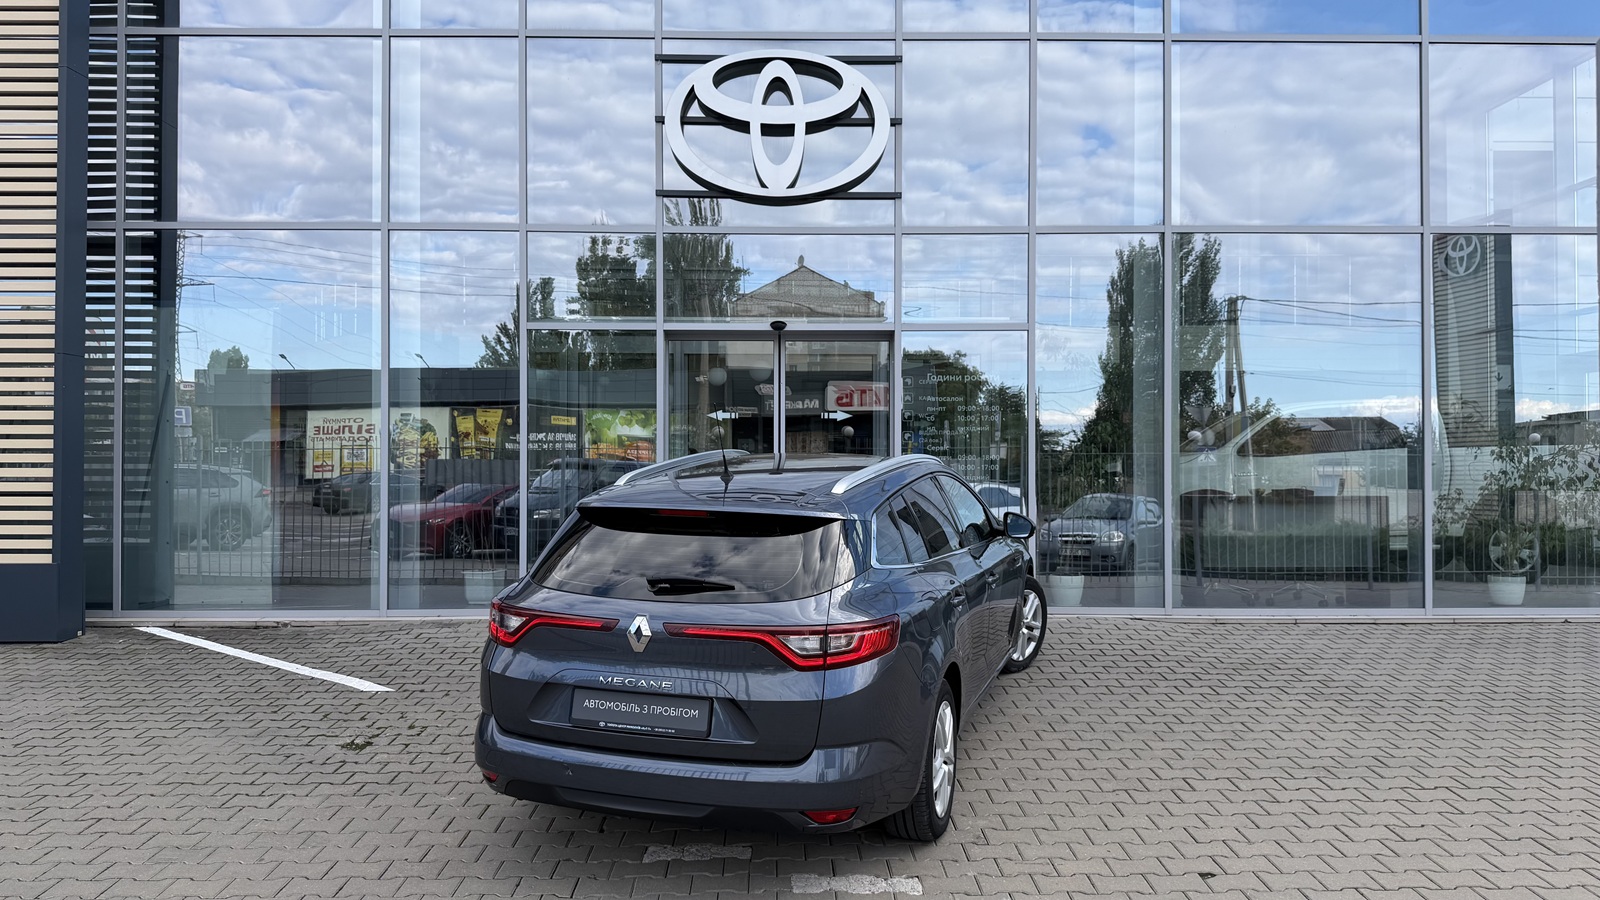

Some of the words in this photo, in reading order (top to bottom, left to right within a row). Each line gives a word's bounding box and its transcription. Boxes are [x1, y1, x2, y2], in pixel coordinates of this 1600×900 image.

[927, 373, 961, 382] Години
[962, 473, 990, 481] ихідний
[599, 675, 674, 691] MEGANE
[583, 699, 641, 713] АВТОМОБІЛЬ
[642, 704, 648, 714] З
[650, 706, 699, 718] ПРОБІГОМ
